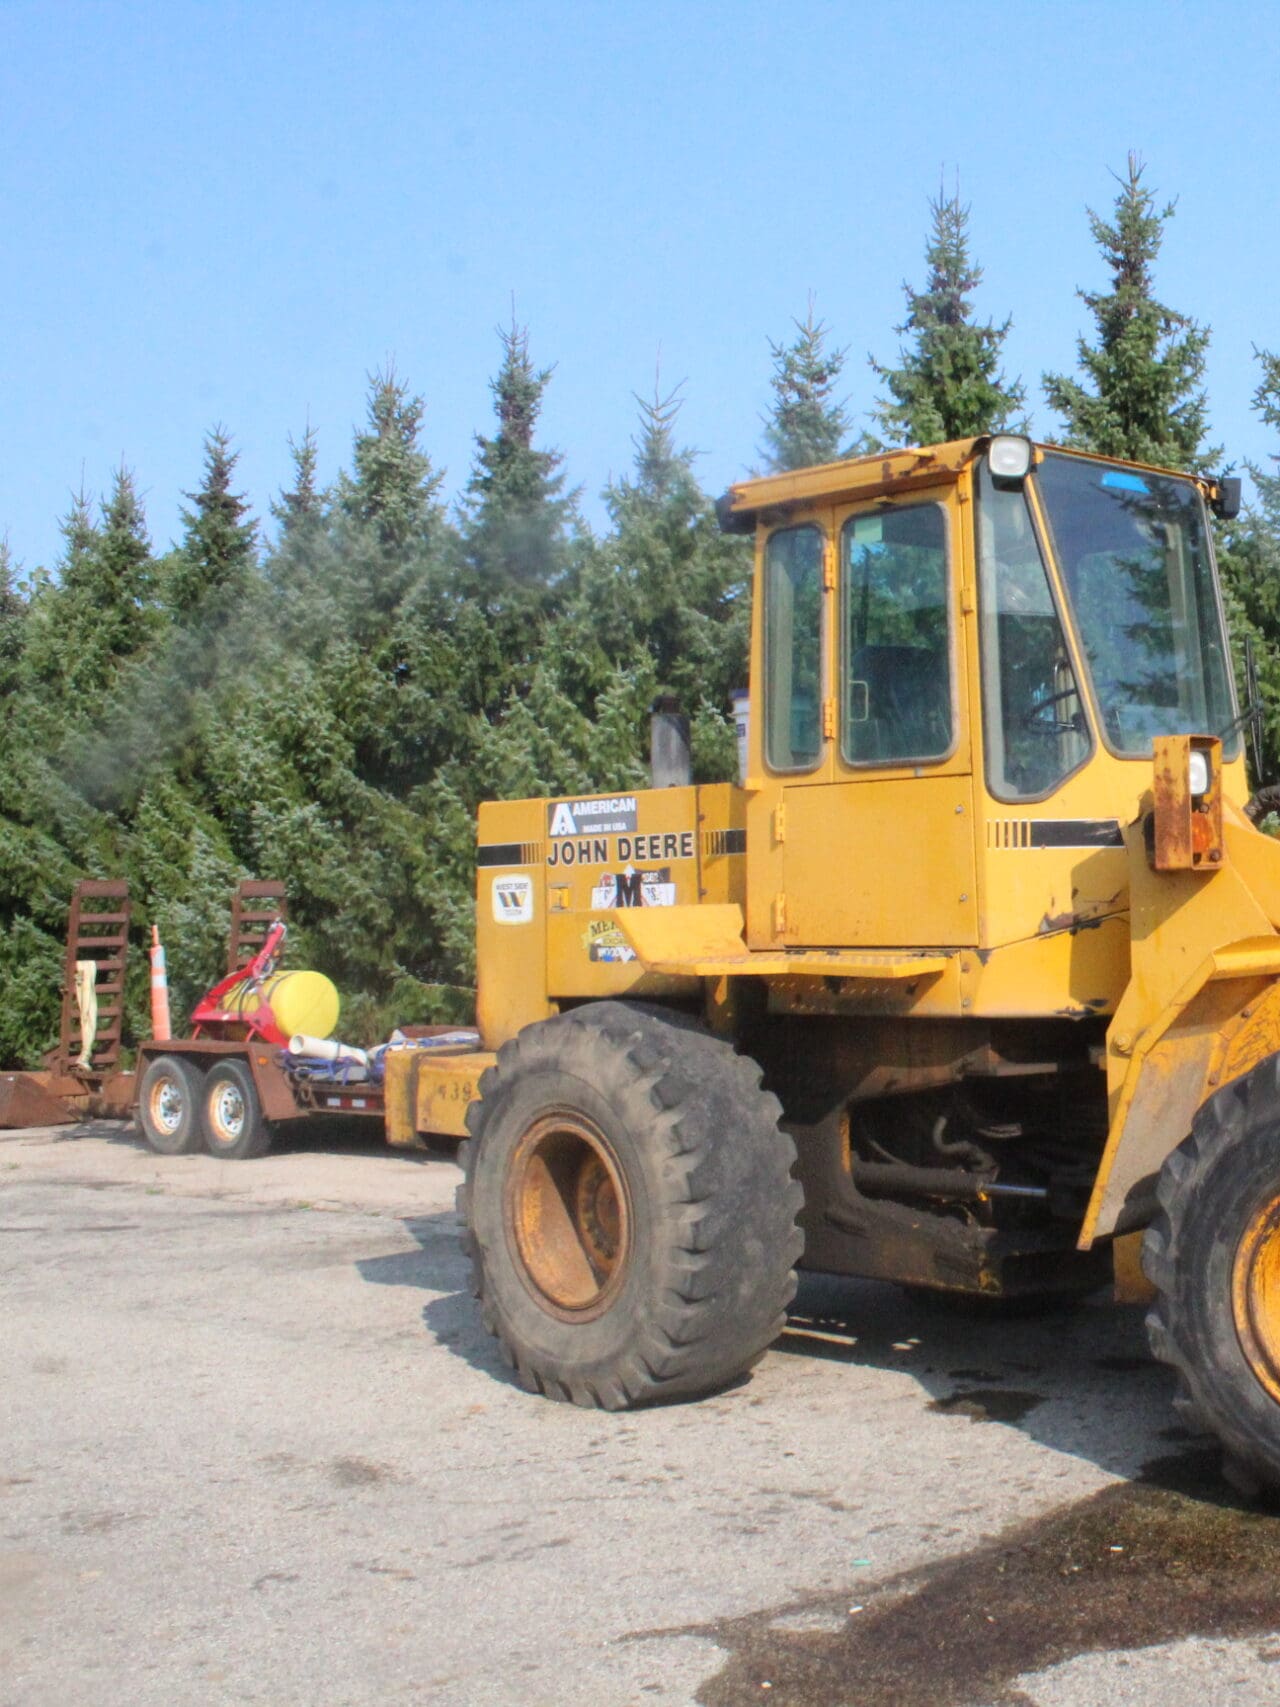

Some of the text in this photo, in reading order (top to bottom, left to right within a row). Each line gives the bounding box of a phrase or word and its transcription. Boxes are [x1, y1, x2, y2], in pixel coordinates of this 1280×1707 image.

[573, 797, 636, 816] AMERICAN
[547, 831, 695, 866] JOHN DEERE
